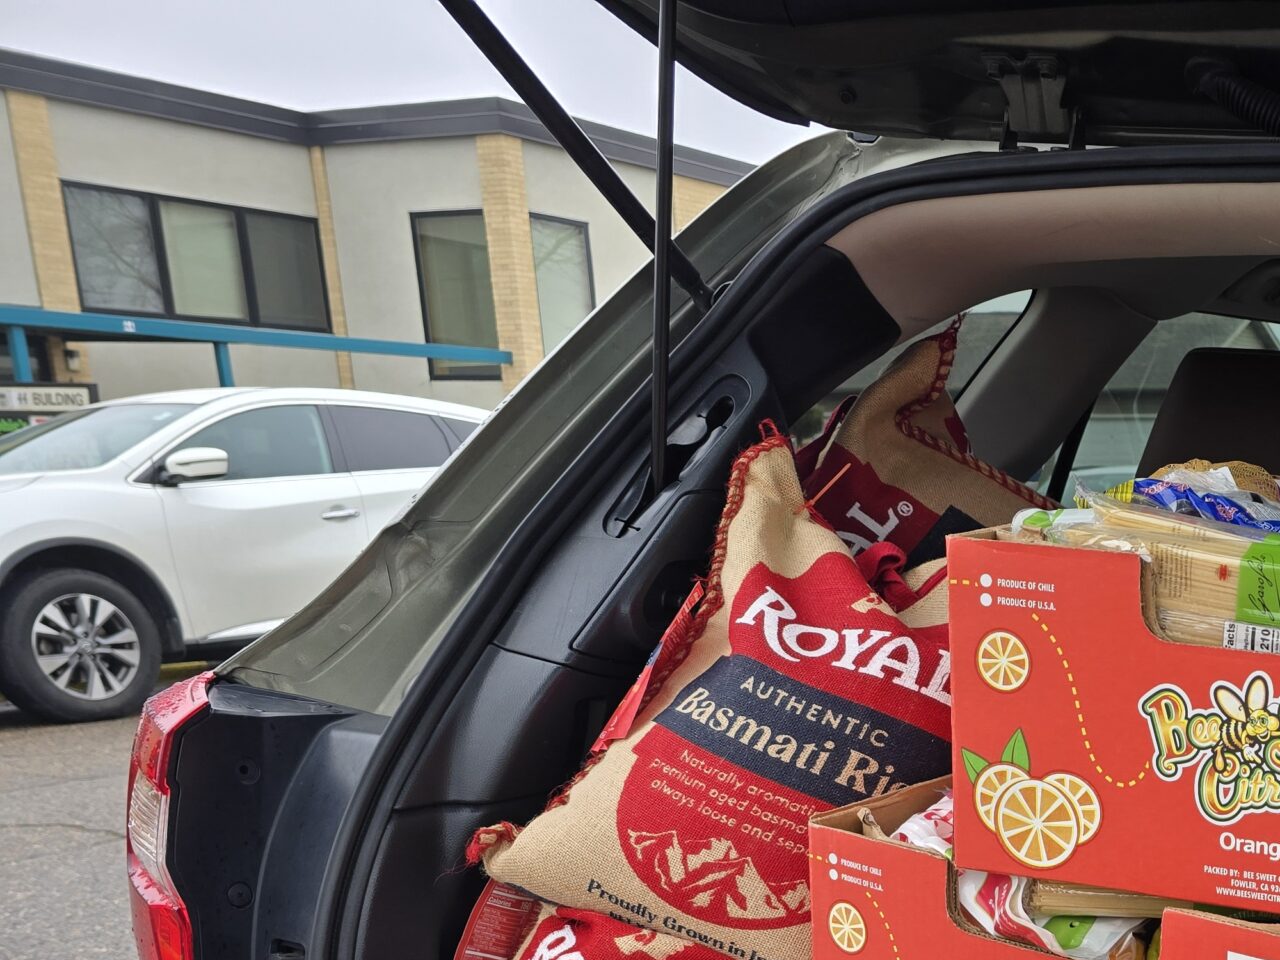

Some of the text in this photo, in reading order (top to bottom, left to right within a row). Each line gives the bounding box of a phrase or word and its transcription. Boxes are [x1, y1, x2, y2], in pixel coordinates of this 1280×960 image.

[32, 392, 84, 406] BUILDING
[997, 578, 1055, 593] PRODUCE OF CHILE
[997, 596, 1057, 611] PRODUCE OF U.S.A.
[1259, 629, 1271, 651] 210
[740, 675, 889, 747] AUTHENTIC
[675, 686, 911, 797] Basmati Ri
[1141, 687, 1224, 777] Bee
[679, 749, 744, 790] Naturally
[650, 758, 807, 834] premium aged basma
[651, 778, 695, 808] always
[698, 800, 737, 827] loose
[741, 823, 775, 842] and
[840, 858, 861, 871] PRODUCE
[862, 864, 869, 872] OF
[1203, 865, 1228, 876] PACKED
[1229, 868, 1240, 877] BY:
[1243, 870, 1254, 879] BEE
[1256, 872, 1276, 882] SWEET
[1230, 879, 1258, 890] FOWLER,
[1260, 883, 1269, 891] CA
[587, 878, 658, 923] Proudly
[662, 916, 724, 950] Grown
[728, 941, 746, 959] in
